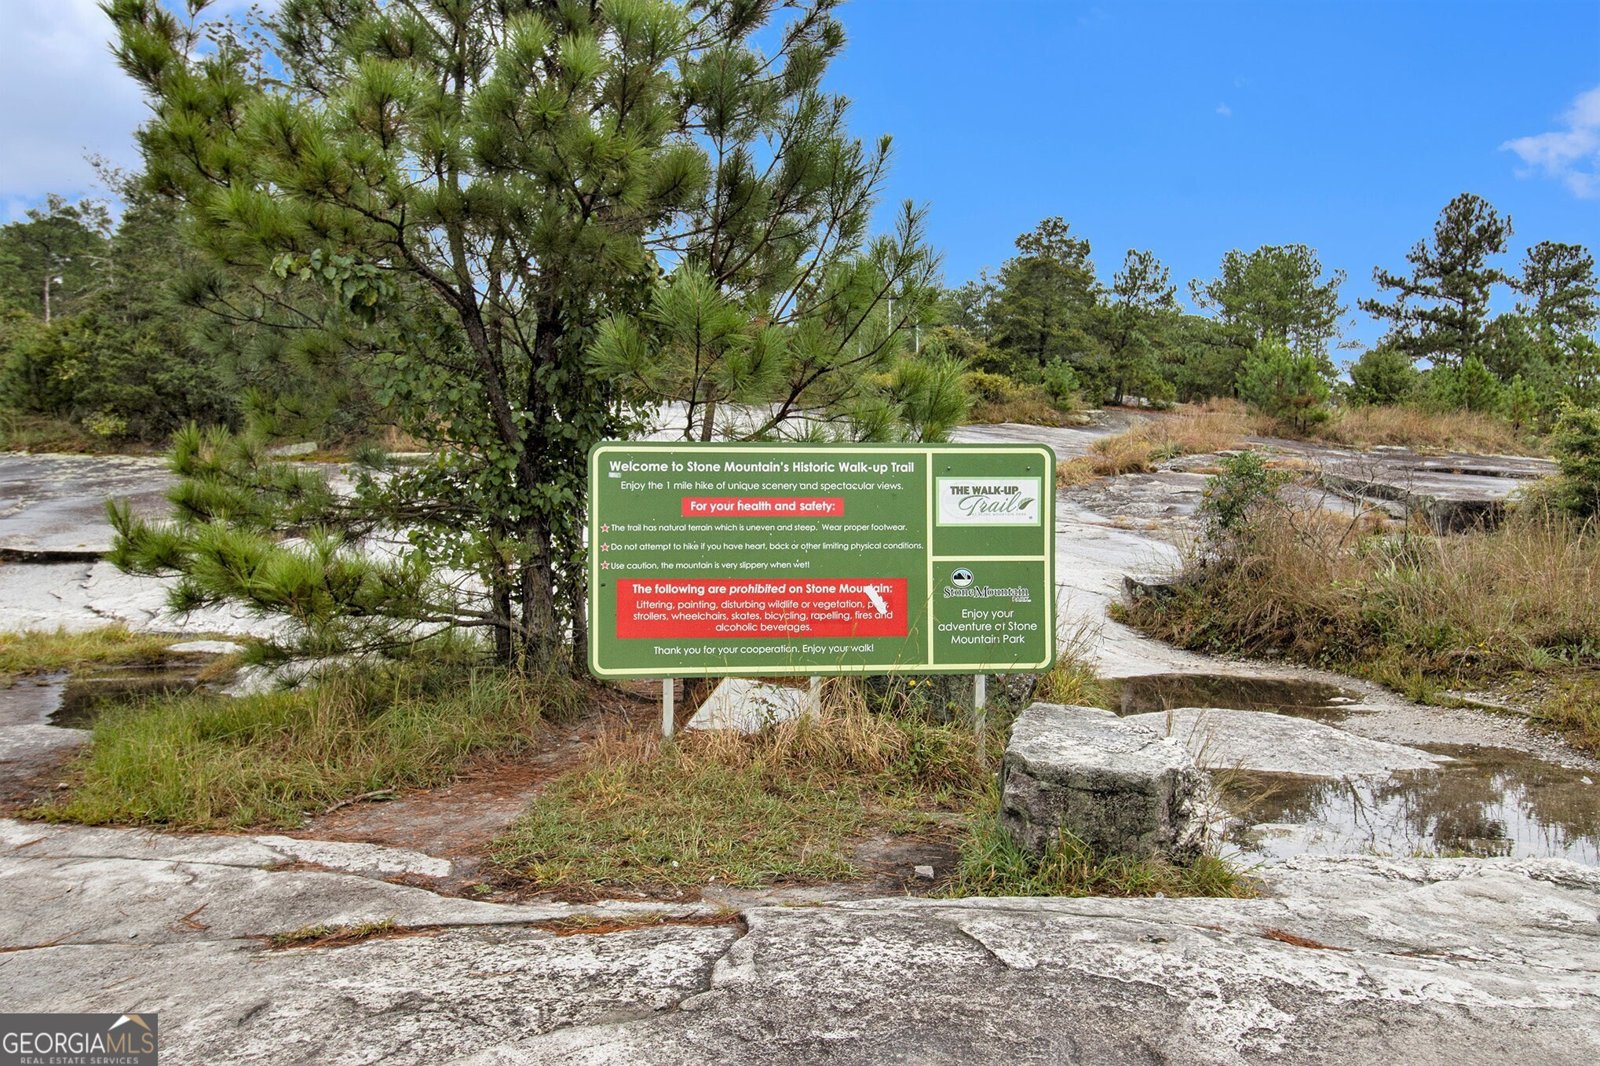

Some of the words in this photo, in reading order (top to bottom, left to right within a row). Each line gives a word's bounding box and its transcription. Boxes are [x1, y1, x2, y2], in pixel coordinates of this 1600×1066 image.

[609, 461, 668, 472] Welcome
[672, 461, 684, 472] to
[687, 461, 721, 472] Stone
[724, 461, 790, 472] Mountain's
[792, 461, 835, 472] Historic
[838, 462, 888, 474] Walk-up
[890, 462, 914, 472] Trail
[620, 481, 646, 491] Enjoy
[648, 481, 664, 490] the
[666, 481, 670, 490] 1
[674, 481, 692, 490] mile
[695, 481, 714, 490] hike
[716, 481, 726, 490] of
[728, 482, 760, 491] unique
[800, 481, 818, 490] and
[820, 482, 874, 491] spectacular
[877, 482, 904, 490] views.
[950, 486, 970, 495] THE
[972, 486, 1018, 495] WALK-UP
[690, 501, 707, 511] For
[710, 503, 734, 513] your
[737, 501, 771, 511] health
[774, 501, 796, 511] and
[800, 502, 836, 512] safety:
[958, 491, 1022, 516] Trail
[794, 524, 818, 532] steep.
[640, 543, 671, 551] attempt
[770, 542, 789, 550] back
[801, 542, 820, 550] other
[822, 542, 848, 551] limiting
[850, 542, 881, 551] physical
[883, 542, 924, 550] conditions.
[740, 562, 768, 570] slippery
[632, 584, 652, 594] The
[655, 584, 704, 596] following
[708, 586, 726, 594] are
[729, 584, 786, 595] prohibited
[789, 586, 802, 594] on
[806, 584, 836, 594] Stone
[839, 584, 892, 594] Mouain:
[636, 600, 675, 610] Littering,
[678, 600, 718, 610] painting,
[721, 600, 766, 610] disturbing
[768, 600, 798, 608] wildlife
[812, 600, 864, 610] vegetation,
[634, 612, 668, 620] strollers,
[671, 612, 729, 620] wheelchairs,
[732, 612, 762, 620] skates,
[764, 612, 808, 621] bicycling,
[810, 612, 852, 622] rapelling,
[962, 609, 988, 620] Enjoy
[992, 609, 1014, 620] your
[716, 623, 757, 631] alcoholic
[760, 623, 812, 632] beverages.
[938, 622, 992, 631] adventure
[1008, 622, 1038, 630] Stone
[951, 634, 1000, 644] Mountain
[1002, 634, 1025, 644] Park
[654, 646, 682, 654] Thank
[684, 647, 700, 656] you
[704, 646, 715, 654] for
[718, 647, 738, 656] your
[740, 645, 800, 654] cooperation.
[802, 644, 826, 654] Enjoy
[828, 646, 848, 654] your
[851, 644, 874, 652] walk!
